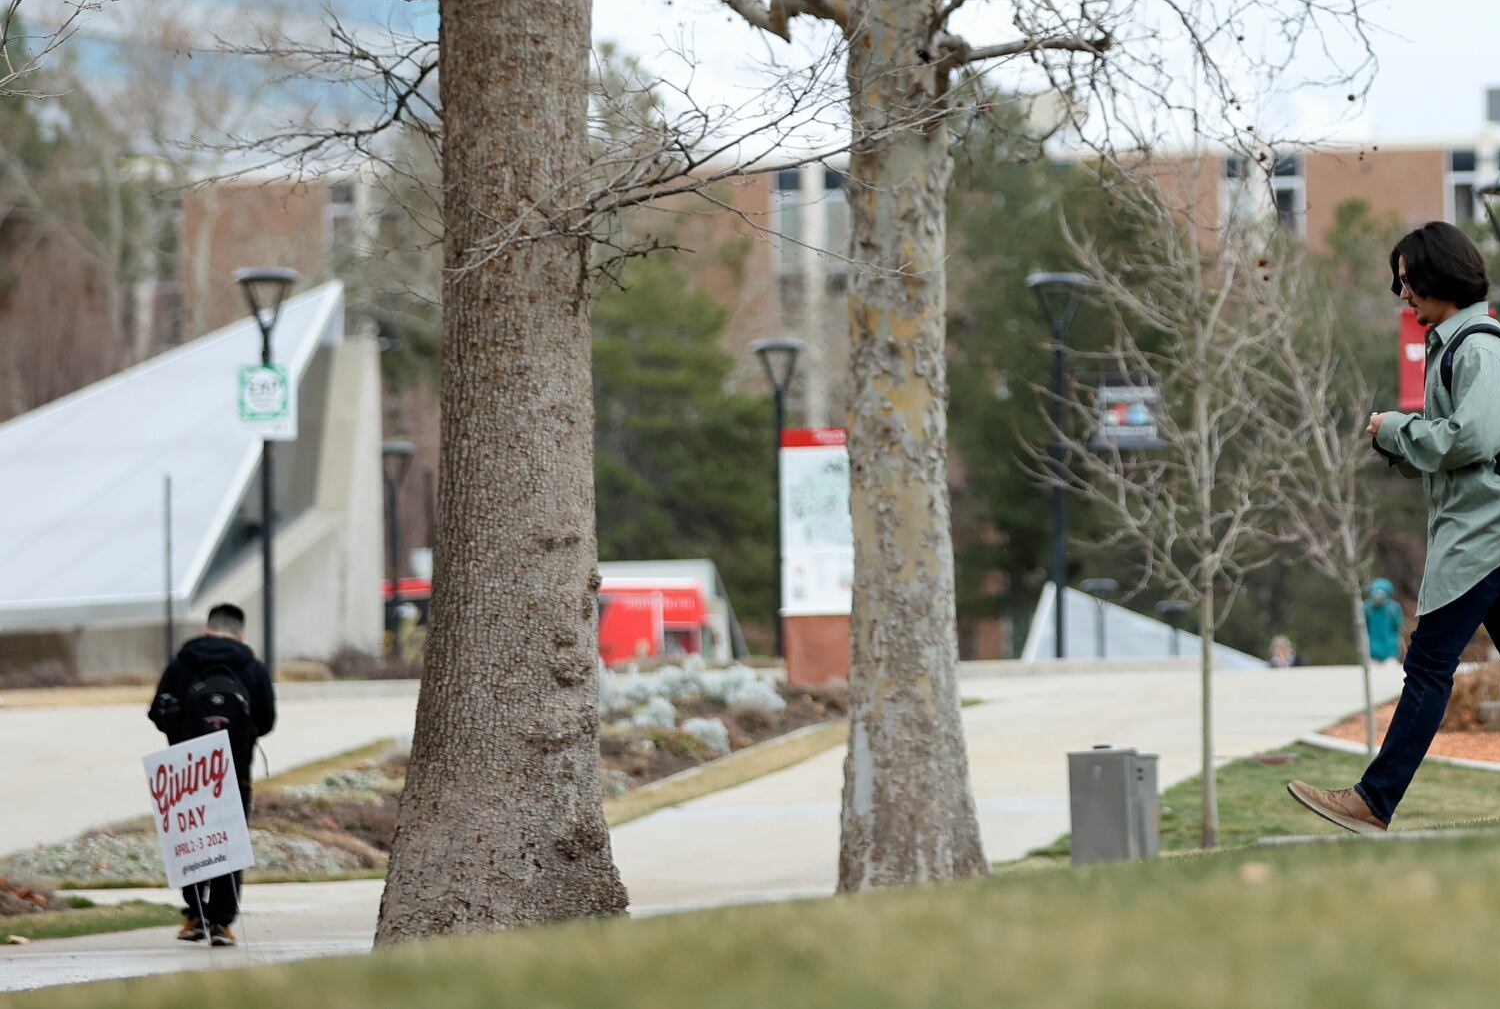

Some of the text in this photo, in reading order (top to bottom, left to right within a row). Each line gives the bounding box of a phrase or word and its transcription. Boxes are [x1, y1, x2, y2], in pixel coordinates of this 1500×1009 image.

[150, 748, 229, 833] Giving
[177, 805, 205, 832] DAY
[207, 831, 228, 847] 2024
